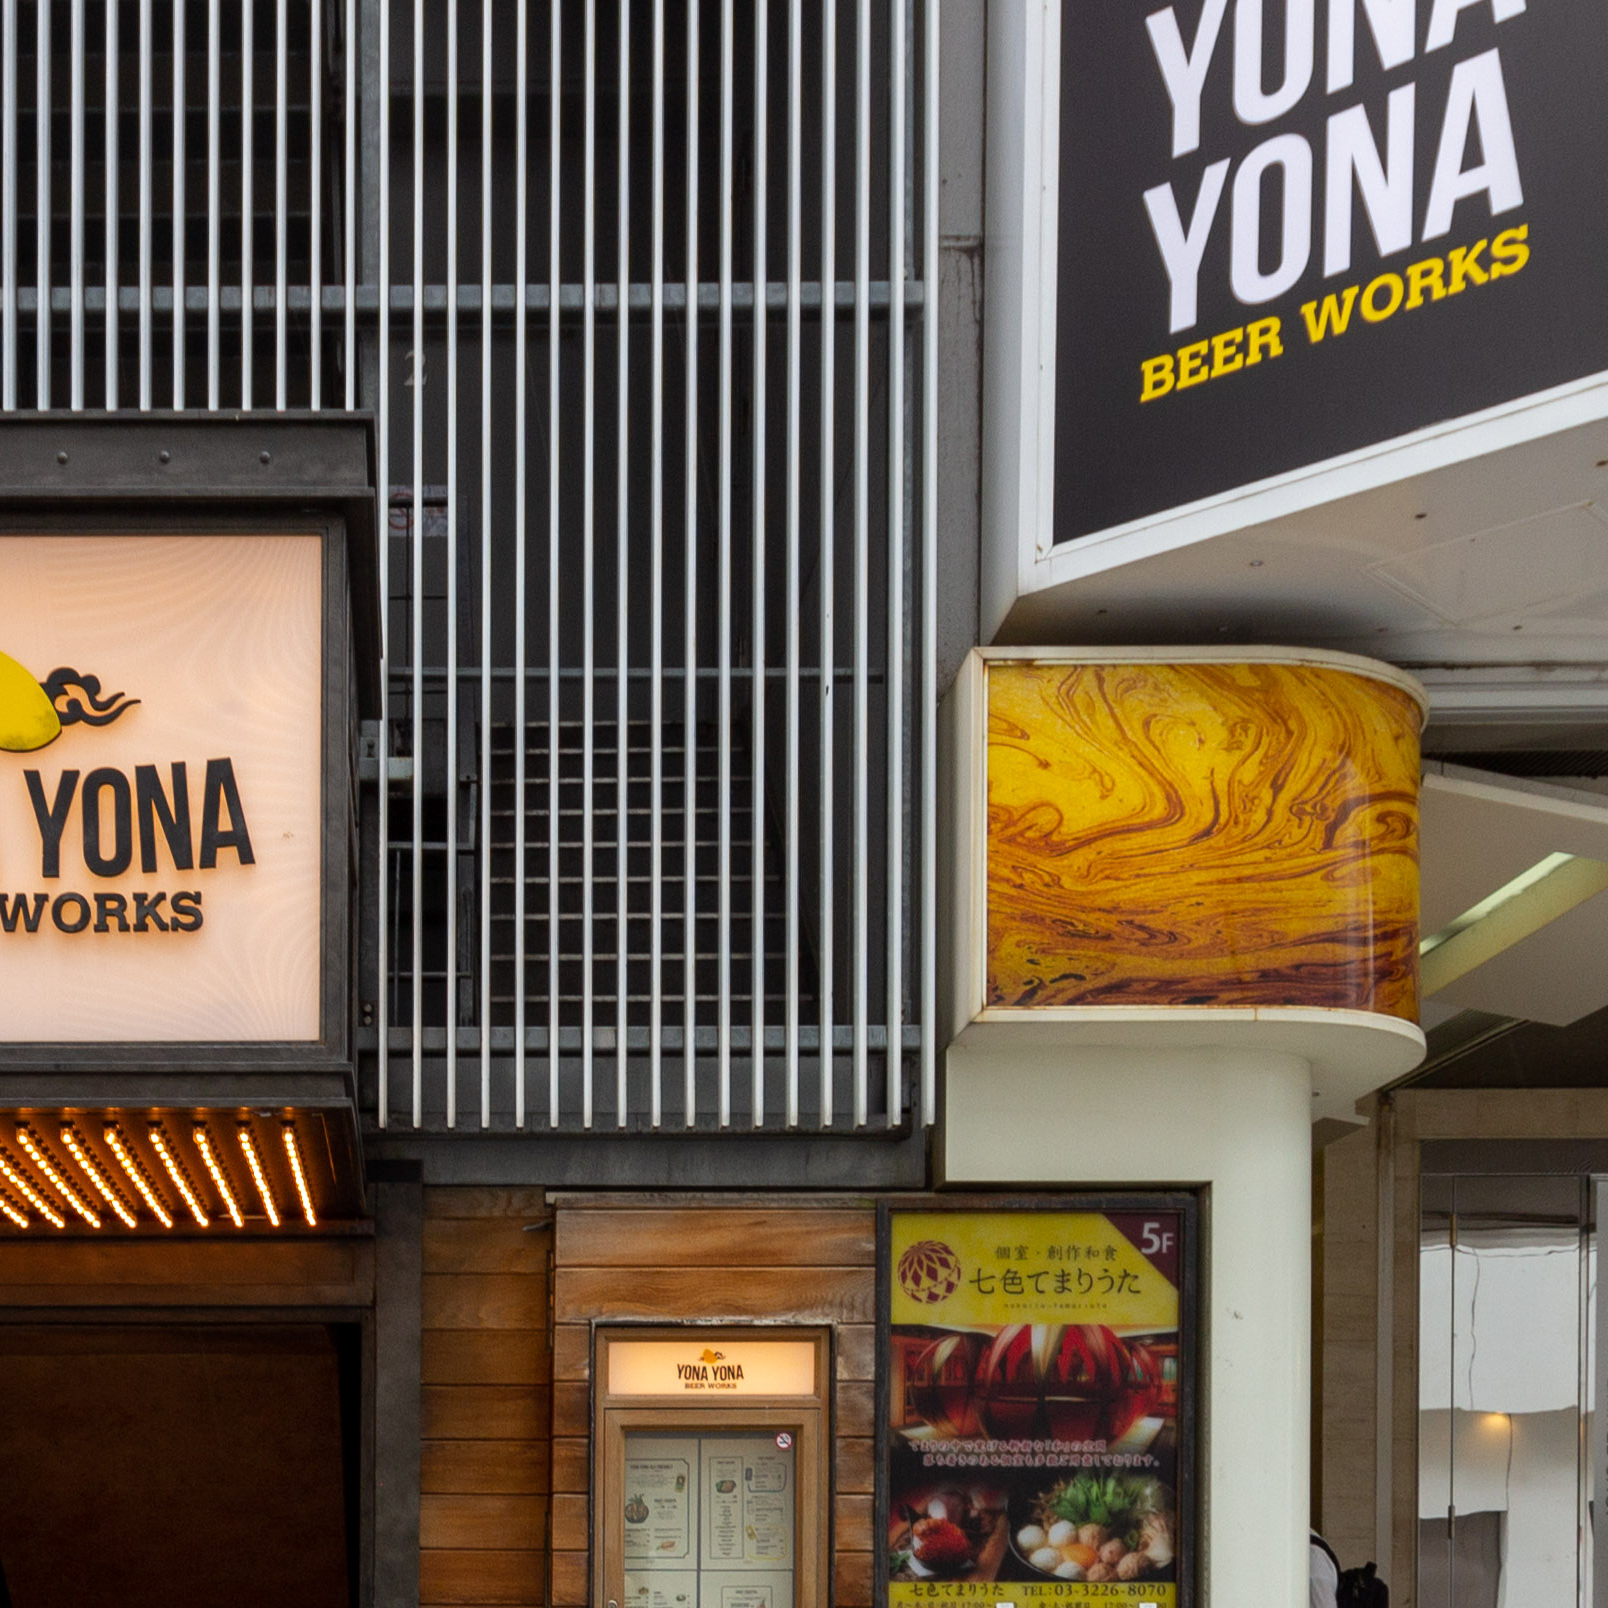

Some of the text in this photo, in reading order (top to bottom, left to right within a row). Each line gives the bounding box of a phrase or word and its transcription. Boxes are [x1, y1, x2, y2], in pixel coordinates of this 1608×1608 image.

[1145, 0, 1527, 159] YON
[1143, 47, 1525, 335] YONA
[1140, 225, 1531, 403] BEER WORKS
[22, 756, 257, 879] YONA
[1140, 1221, 1175, 1256] 5F
[968, 1267, 1142, 1295] 七色てまりうた
[677, 1364, 744, 1381] YONA YONA
[909, 1583, 1005, 1598] 七色てまりうた
